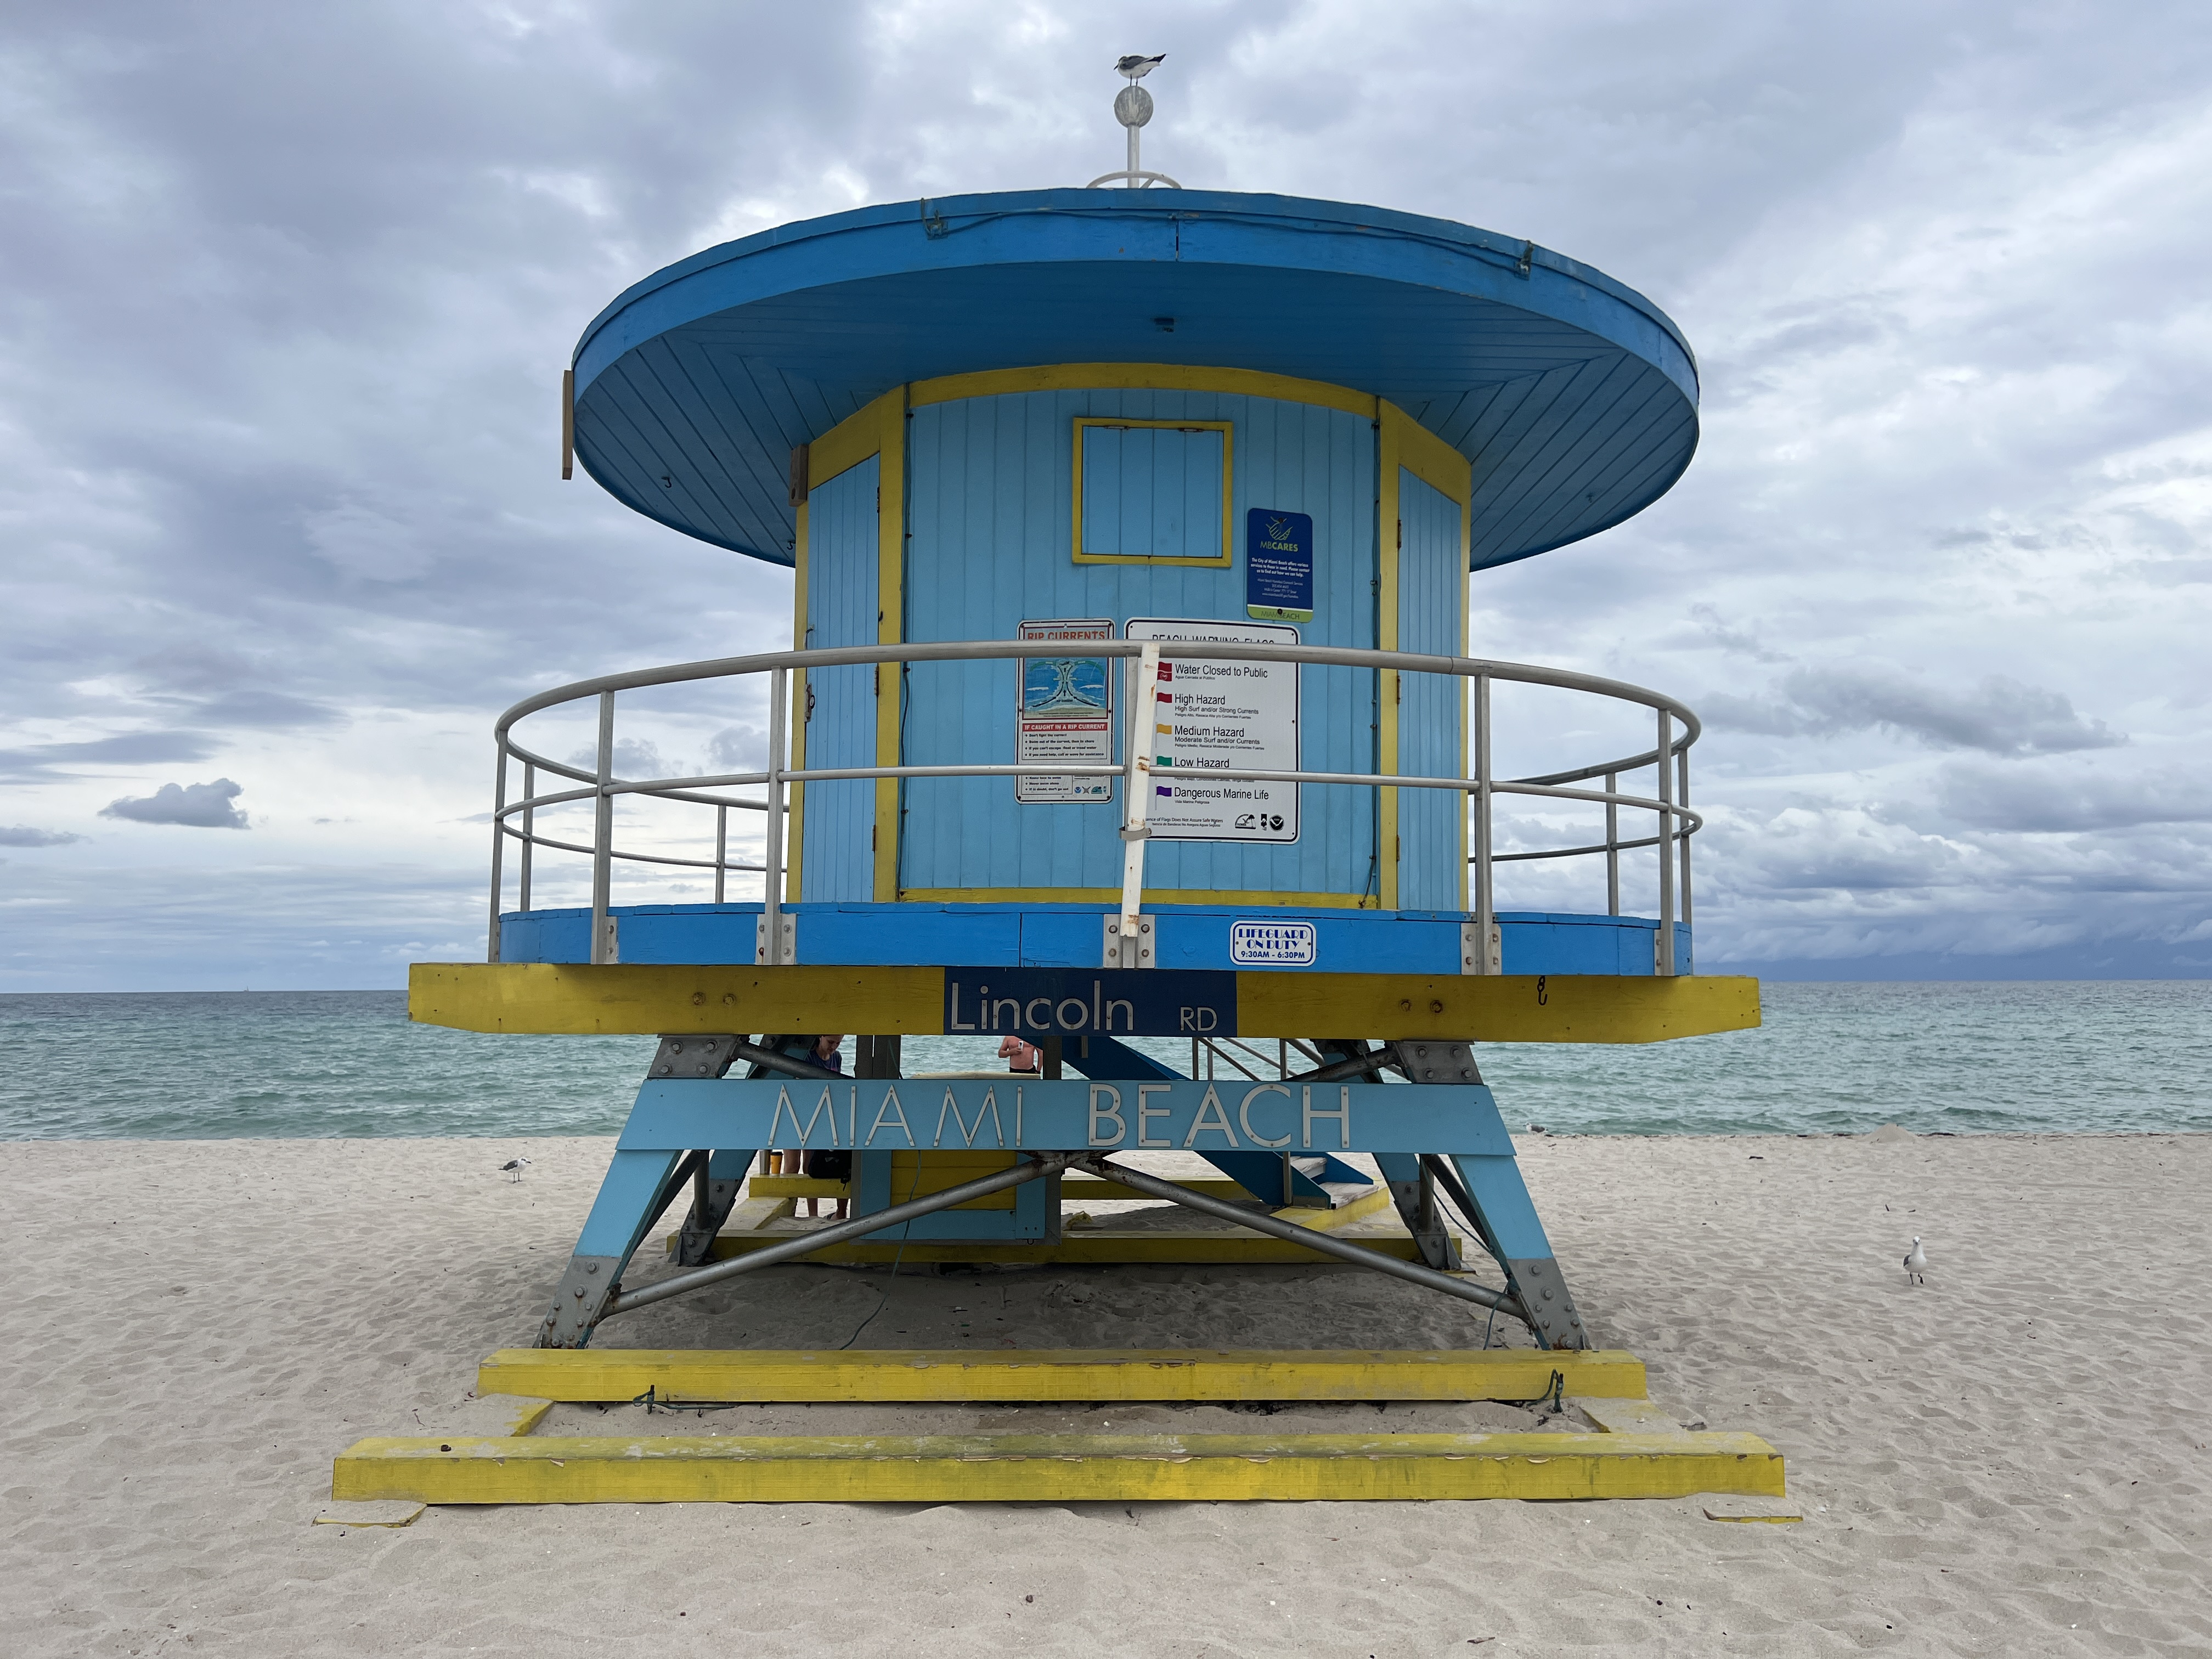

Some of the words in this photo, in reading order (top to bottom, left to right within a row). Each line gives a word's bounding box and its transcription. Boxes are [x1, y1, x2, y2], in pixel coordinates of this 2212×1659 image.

[1260, 540, 1299, 552] MBCARES
[1048, 631, 1105, 640] CURRENTS
[1175, 664, 1200, 674] Water
[1203, 665, 1231, 676] Closed
[1234, 667, 1241, 676] to
[1244, 667, 1268, 678] Public
[1175, 693, 1194, 706] High
[1197, 694, 1225, 705] Hazard
[1175, 725, 1210, 736] Medium
[1214, 726, 1244, 737] Hazard
[1175, 757, 1194, 767] Low
[1197, 757, 1229, 768] Hazard
[1175, 787, 1221, 800] Dangerous
[1223, 788, 1251, 799] Marine
[1255, 789, 1268, 799] Life
[1239, 928, 1308, 939] LIFEGUARD
[1246, 939, 1263, 949] ON
[1267, 940, 1300, 949] DUTY
[951, 980, 1135, 1031] Lincoln
[1180, 1006, 1218, 1032] RD
[768, 1084, 1023, 1148] MIAMI
[1088, 1082, 1350, 1149] BEACH
